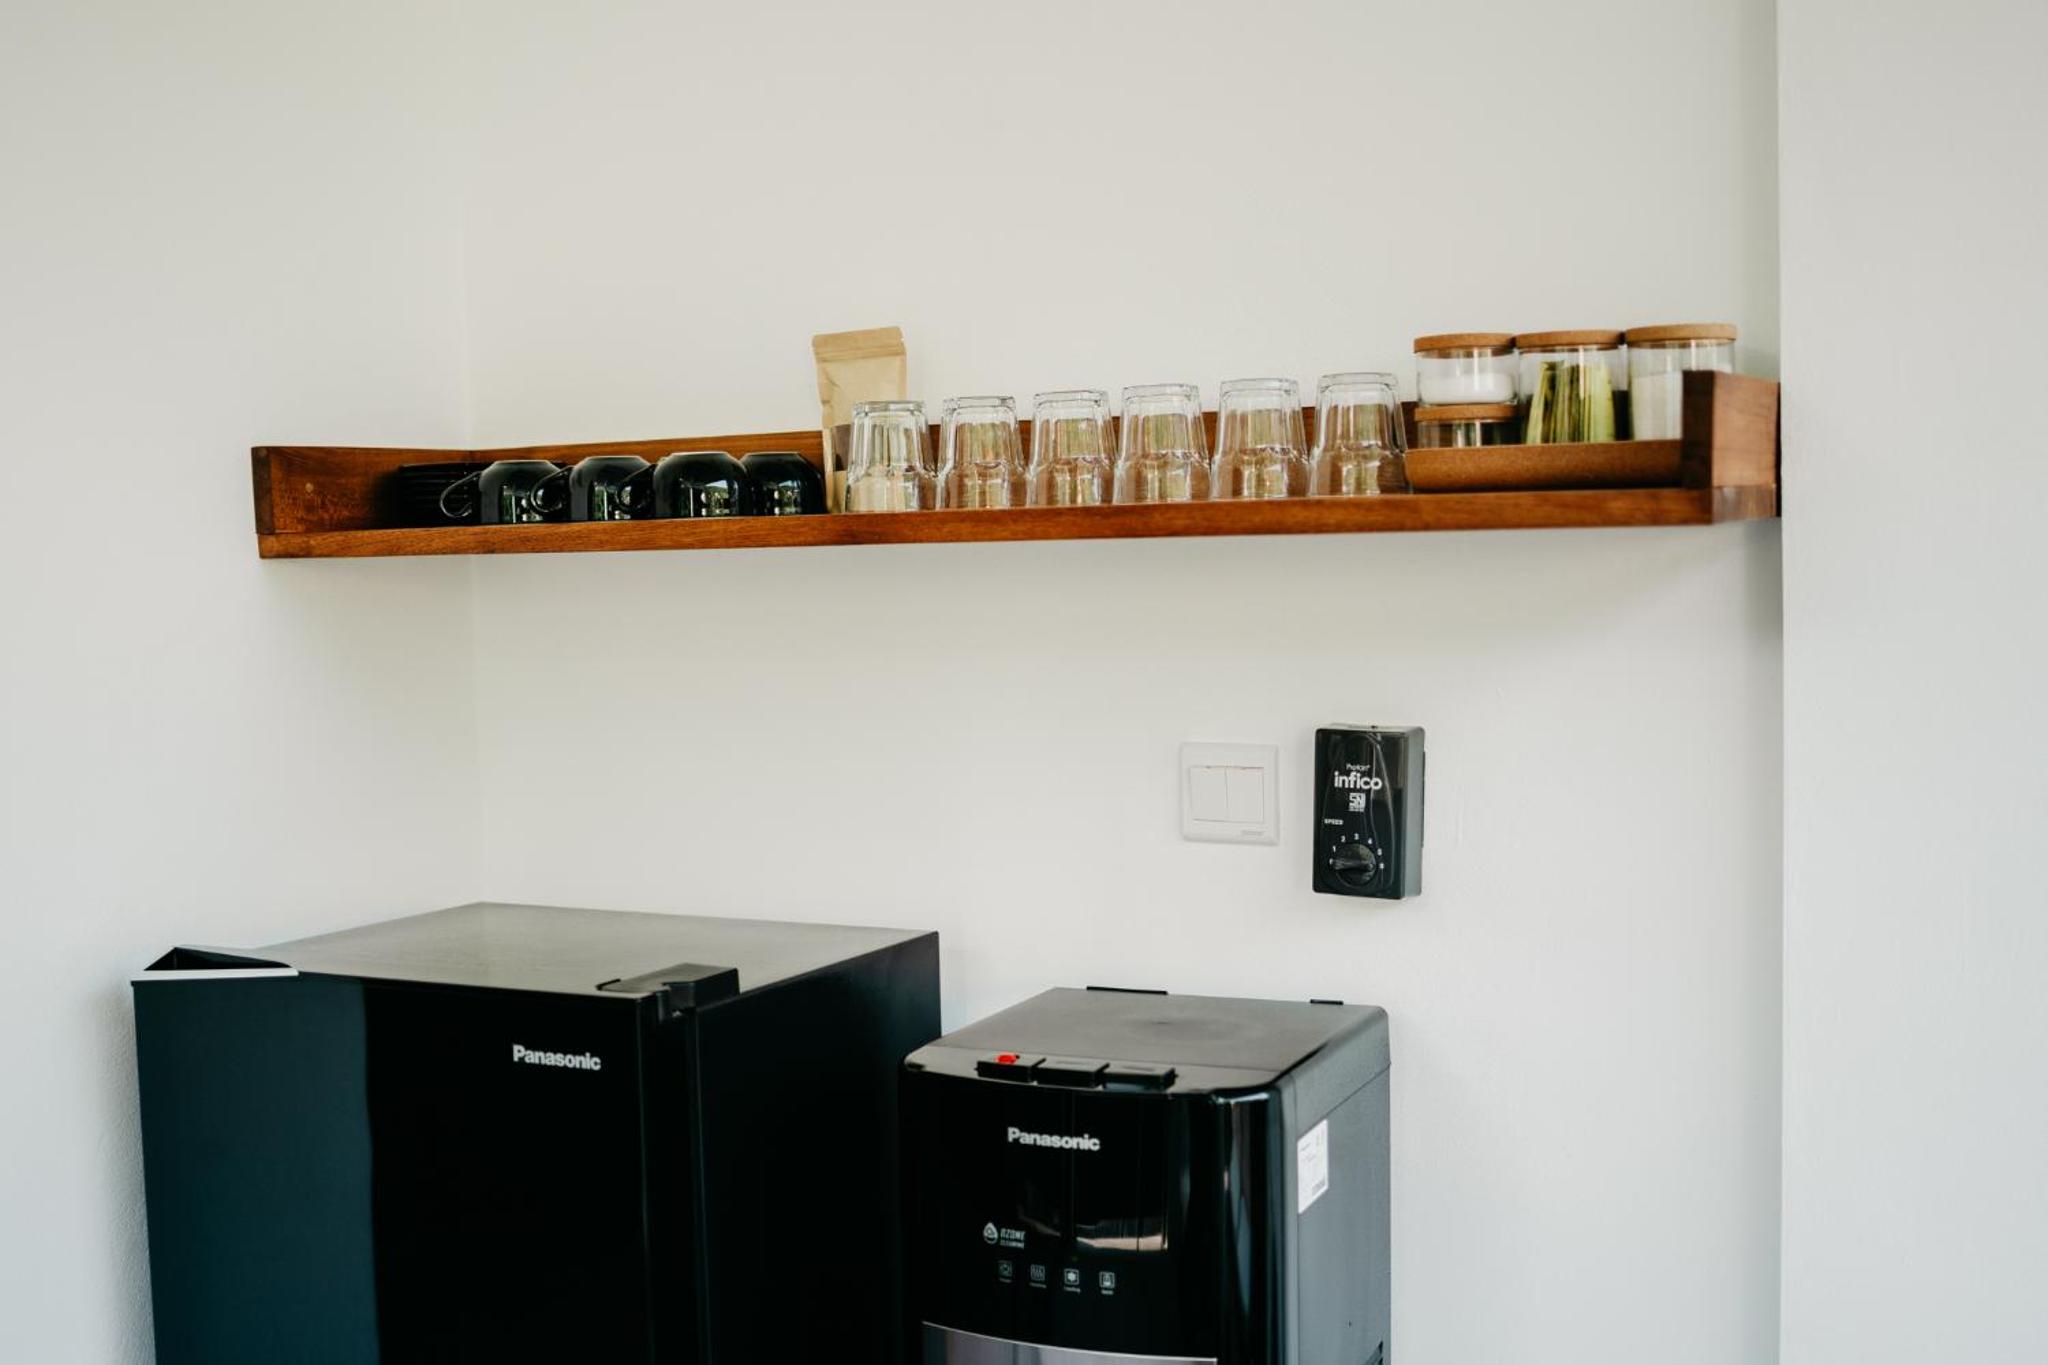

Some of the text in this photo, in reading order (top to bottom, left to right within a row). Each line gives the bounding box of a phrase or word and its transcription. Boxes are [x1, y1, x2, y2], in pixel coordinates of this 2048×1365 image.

[1333, 771, 1383, 790] infico
[512, 1044, 602, 1071] Panasonic
[1007, 1126, 1101, 1151] Panasonic
